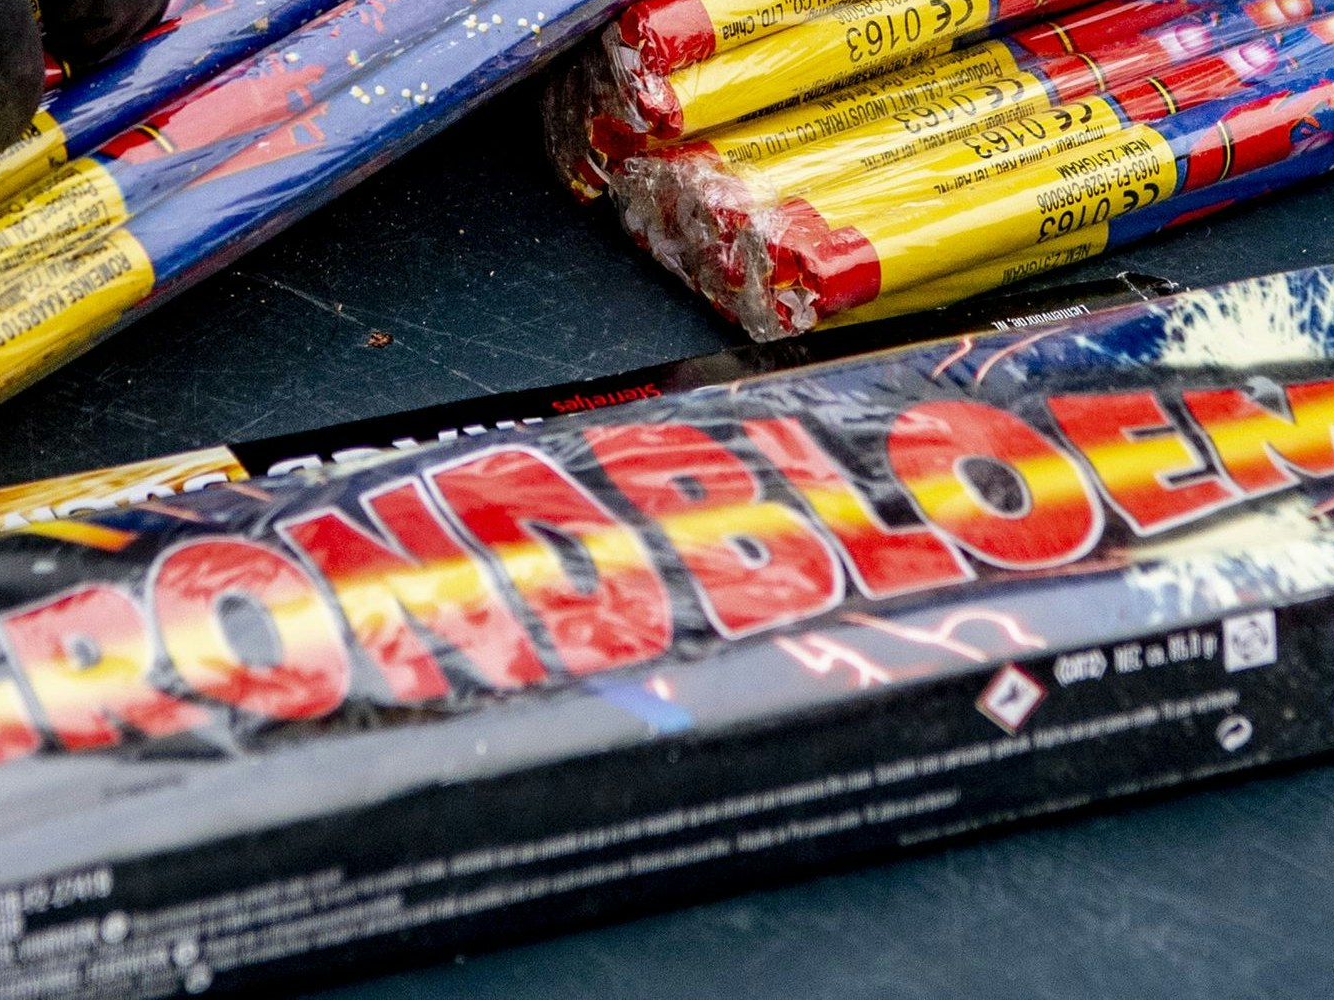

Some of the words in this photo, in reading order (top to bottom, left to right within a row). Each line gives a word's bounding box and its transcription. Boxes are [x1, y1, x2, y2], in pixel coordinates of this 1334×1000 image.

[718, 14, 757, 43] China.
[839, 5, 926, 63] 0163
[916, 79, 944, 103] C&L
[942, 57, 1002, 94] Producent:
[974, 73, 1026, 112] CE
[814, 97, 889, 138] INDUSTRIAL
[891, 90, 977, 139] 0163
[1040, 97, 1094, 135] CE
[962, 113, 1046, 163] 0163
[1115, 135, 1152, 161] NEM:
[1055, 147, 1117, 181] 2,51GRAM
[1034, 154, 1162, 214] 0163-F2-1529-CR5006
[1115, 180, 1163, 214] CE
[1030, 197, 1114, 243] 0163
[60, 250, 132, 304] ROMEINSE
